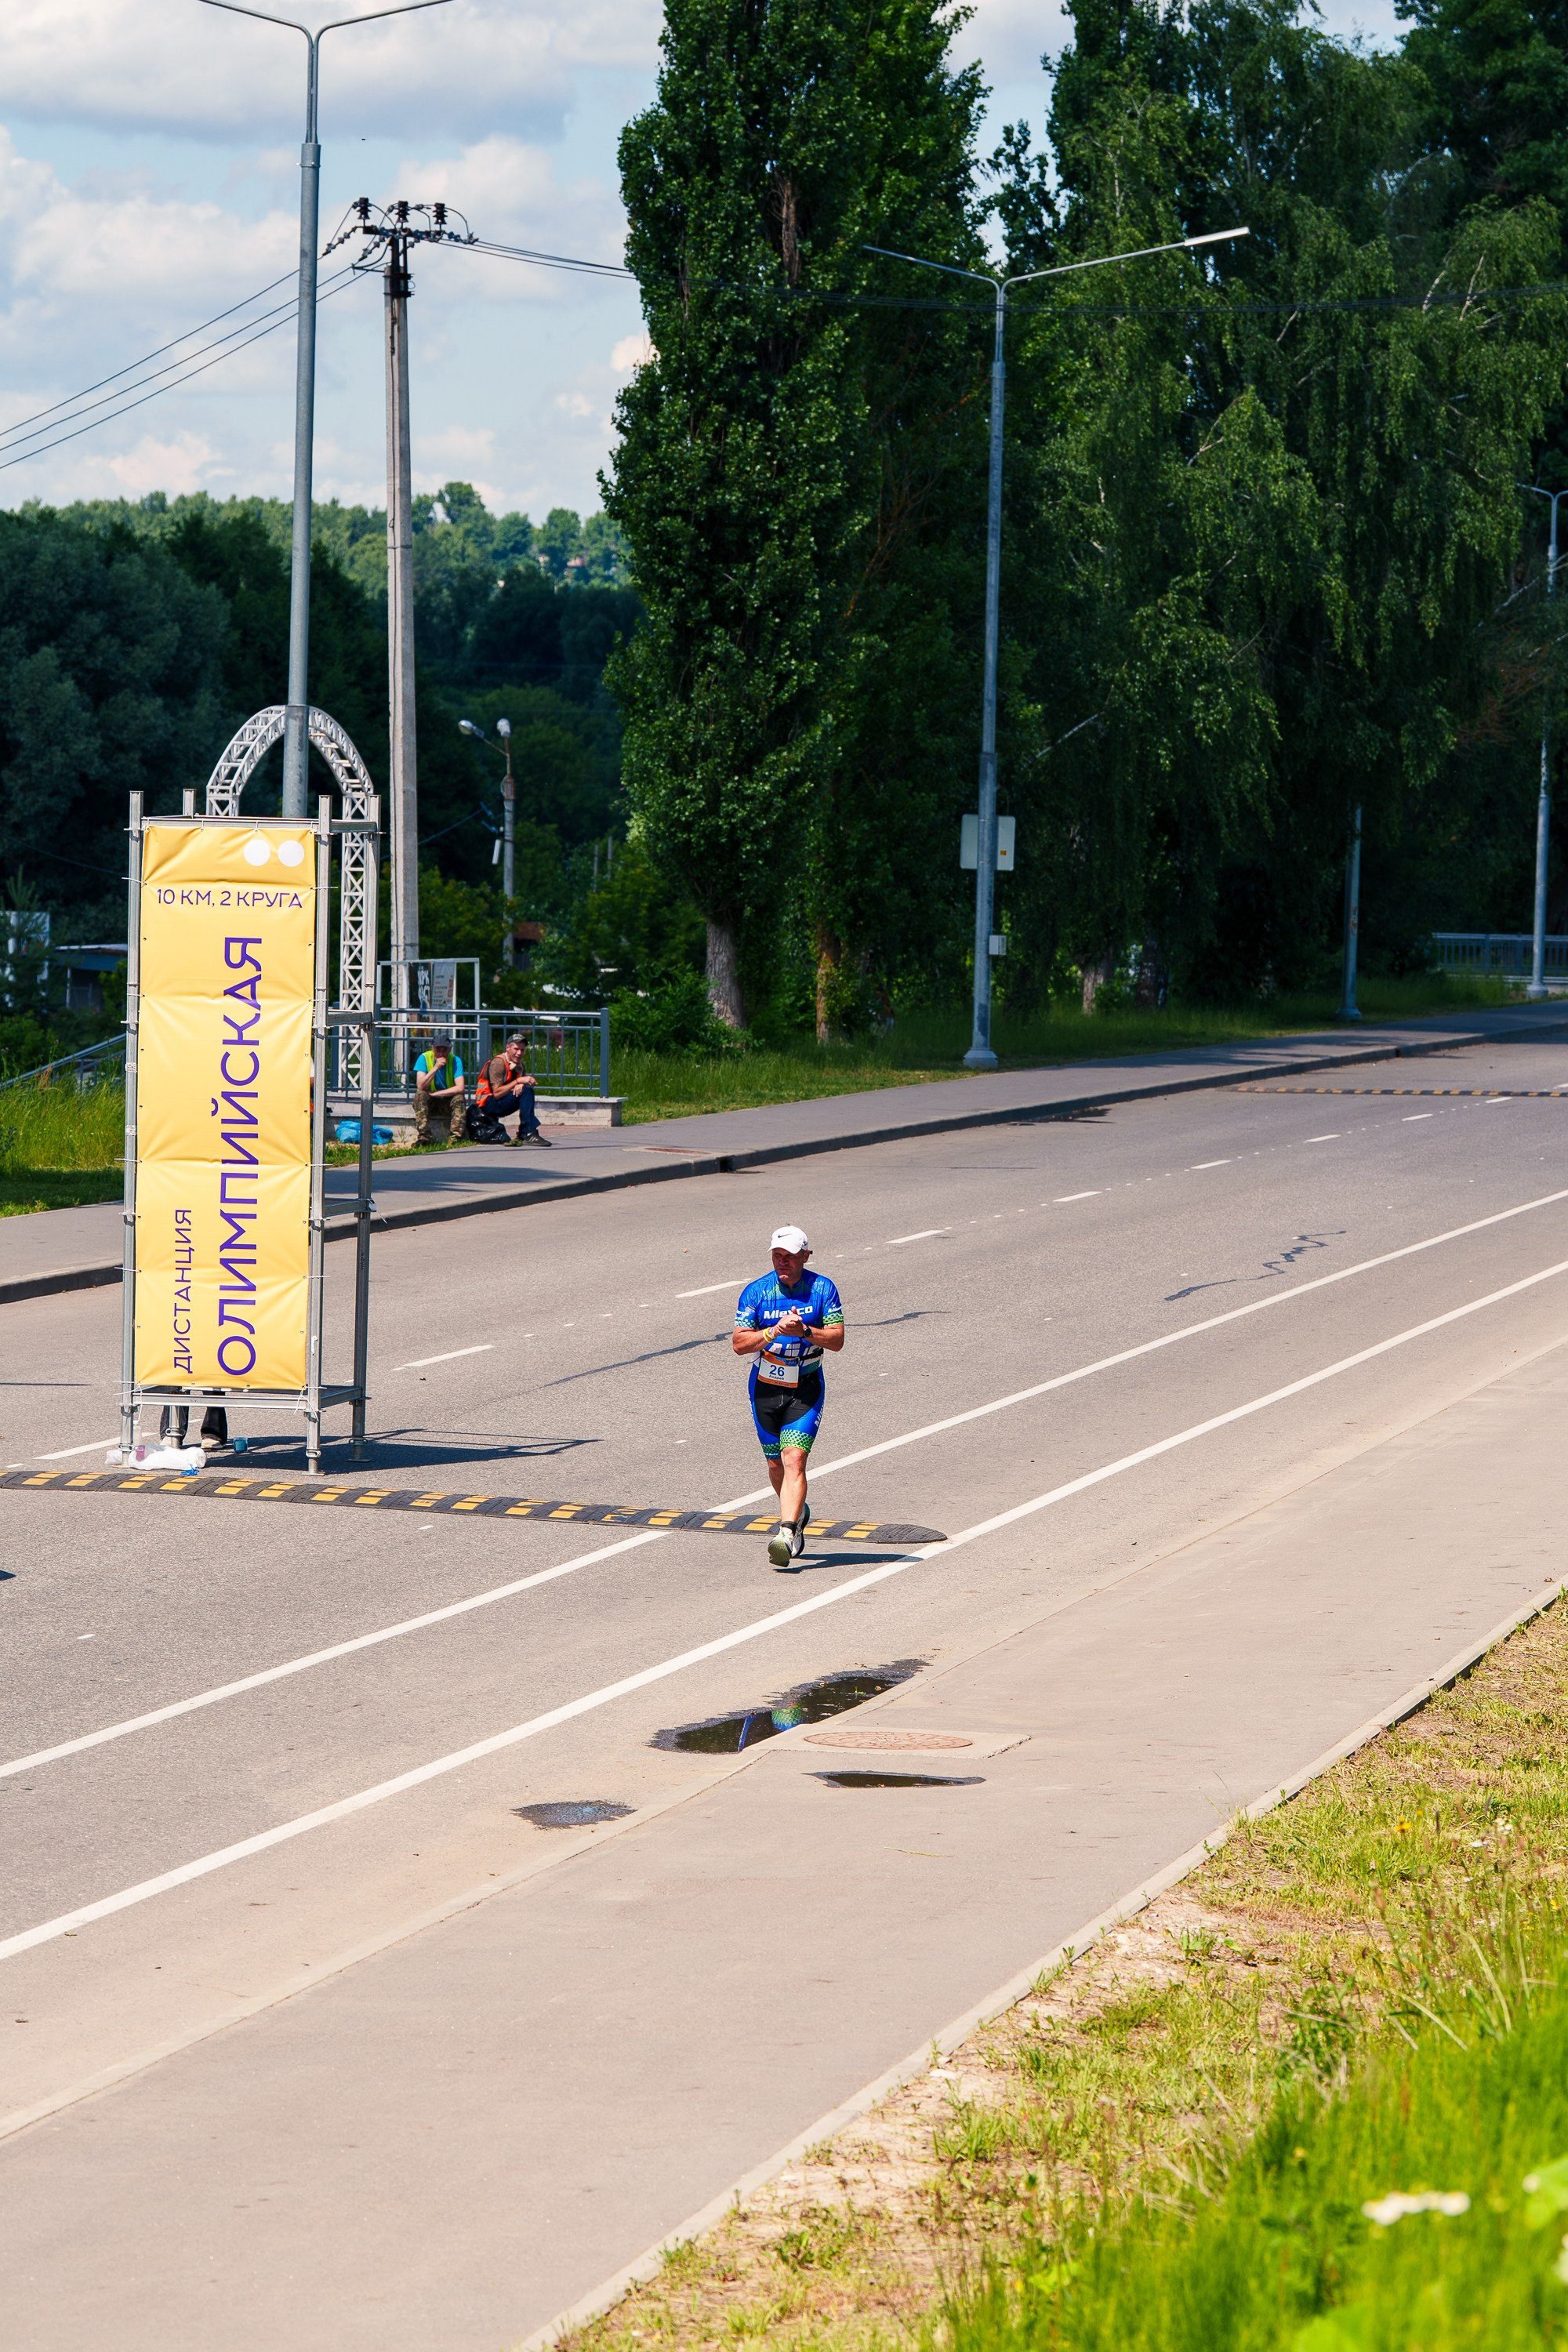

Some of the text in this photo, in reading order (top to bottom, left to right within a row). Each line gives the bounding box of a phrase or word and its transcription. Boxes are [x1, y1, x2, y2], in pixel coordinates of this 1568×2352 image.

[158, 888, 303, 908] 10 КМ, 2 КРУГА
[211, 937, 262, 1376] ОЛИМПИЙСКАЯ
[174, 1208, 194, 1374] ДИСТАНЦИЯ
[769, 1365, 785, 1377] 26
